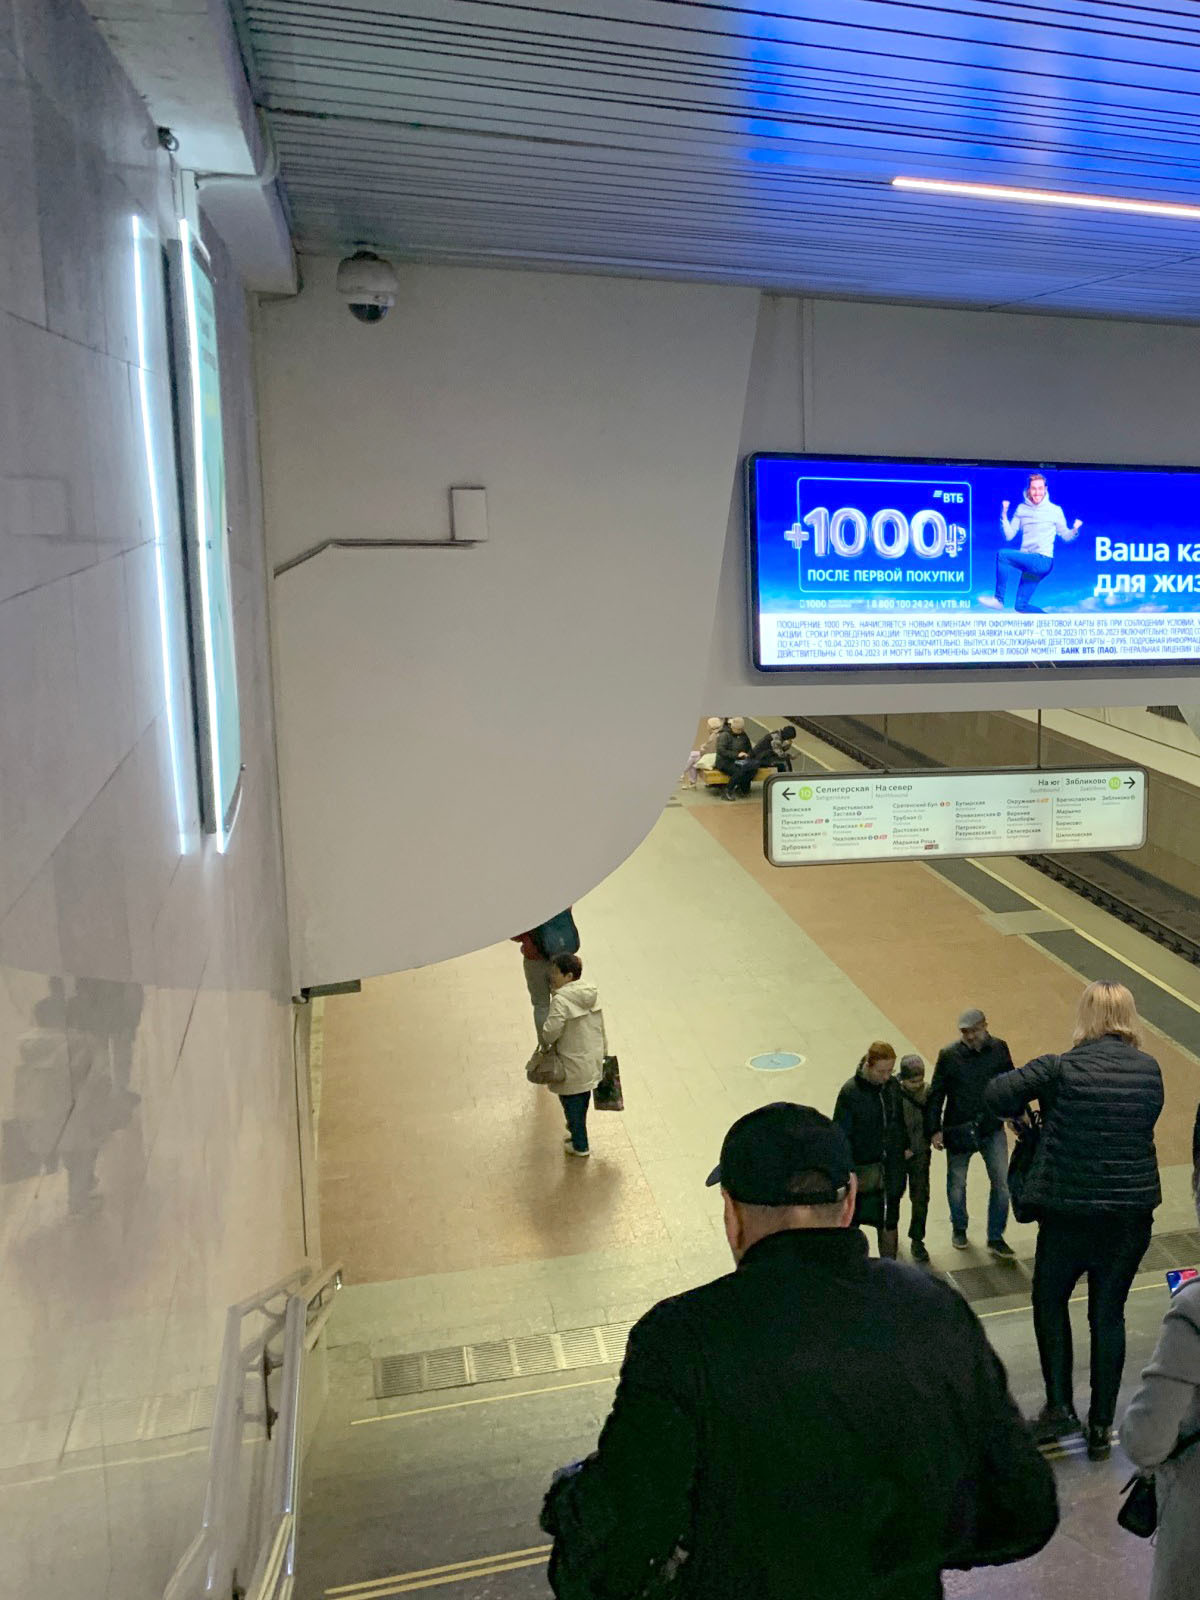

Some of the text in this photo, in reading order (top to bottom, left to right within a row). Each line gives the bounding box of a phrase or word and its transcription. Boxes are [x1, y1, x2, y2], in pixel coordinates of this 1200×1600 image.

[943, 493, 964, 503] ВТБ
[1095, 536, 1170, 562] Ваша
[808, 568, 964, 582] ПОСЛЕ ПЕРВОЙ ПОКУПКИ
[1093, 574, 1146, 597] для
[877, 601, 894, 609] 800
[896, 601, 910, 609] 100
[912, 601, 923, 609] 24
[924, 601, 934, 609] 24
[940, 601, 970, 609] VTB.RU
[824, 620, 839, 628] 1000
[988, 619, 1033, 627] ОФОРМЛЕНИИ
[1036, 619, 1072, 627] ДЕБЕТОВОЙ
[805, 630, 828, 638] СРОКИ
[830, 630, 874, 638] ПРОВЕДЕНИЯ
[978, 629, 1002, 637] ЗАЯВКИ
[824, 639, 859, 647] 10.04.2023
[963, 638, 988, 646] ВЫПУСК
[996, 638, 1046, 646] ОБСЛУЖИВАНИЕ
[777, 649, 836, 657] ДЕЙСТВИТЕЛЬНЫ
[914, 648, 931, 656] БЫТЬ
[933, 648, 968, 656] ИЗМЕНЕНЫ
[1005, 647, 1029, 655] ЛЮБОЙ
[1065, 778, 1106, 786] Зябликово
[816, 786, 869, 794] Селигерская
